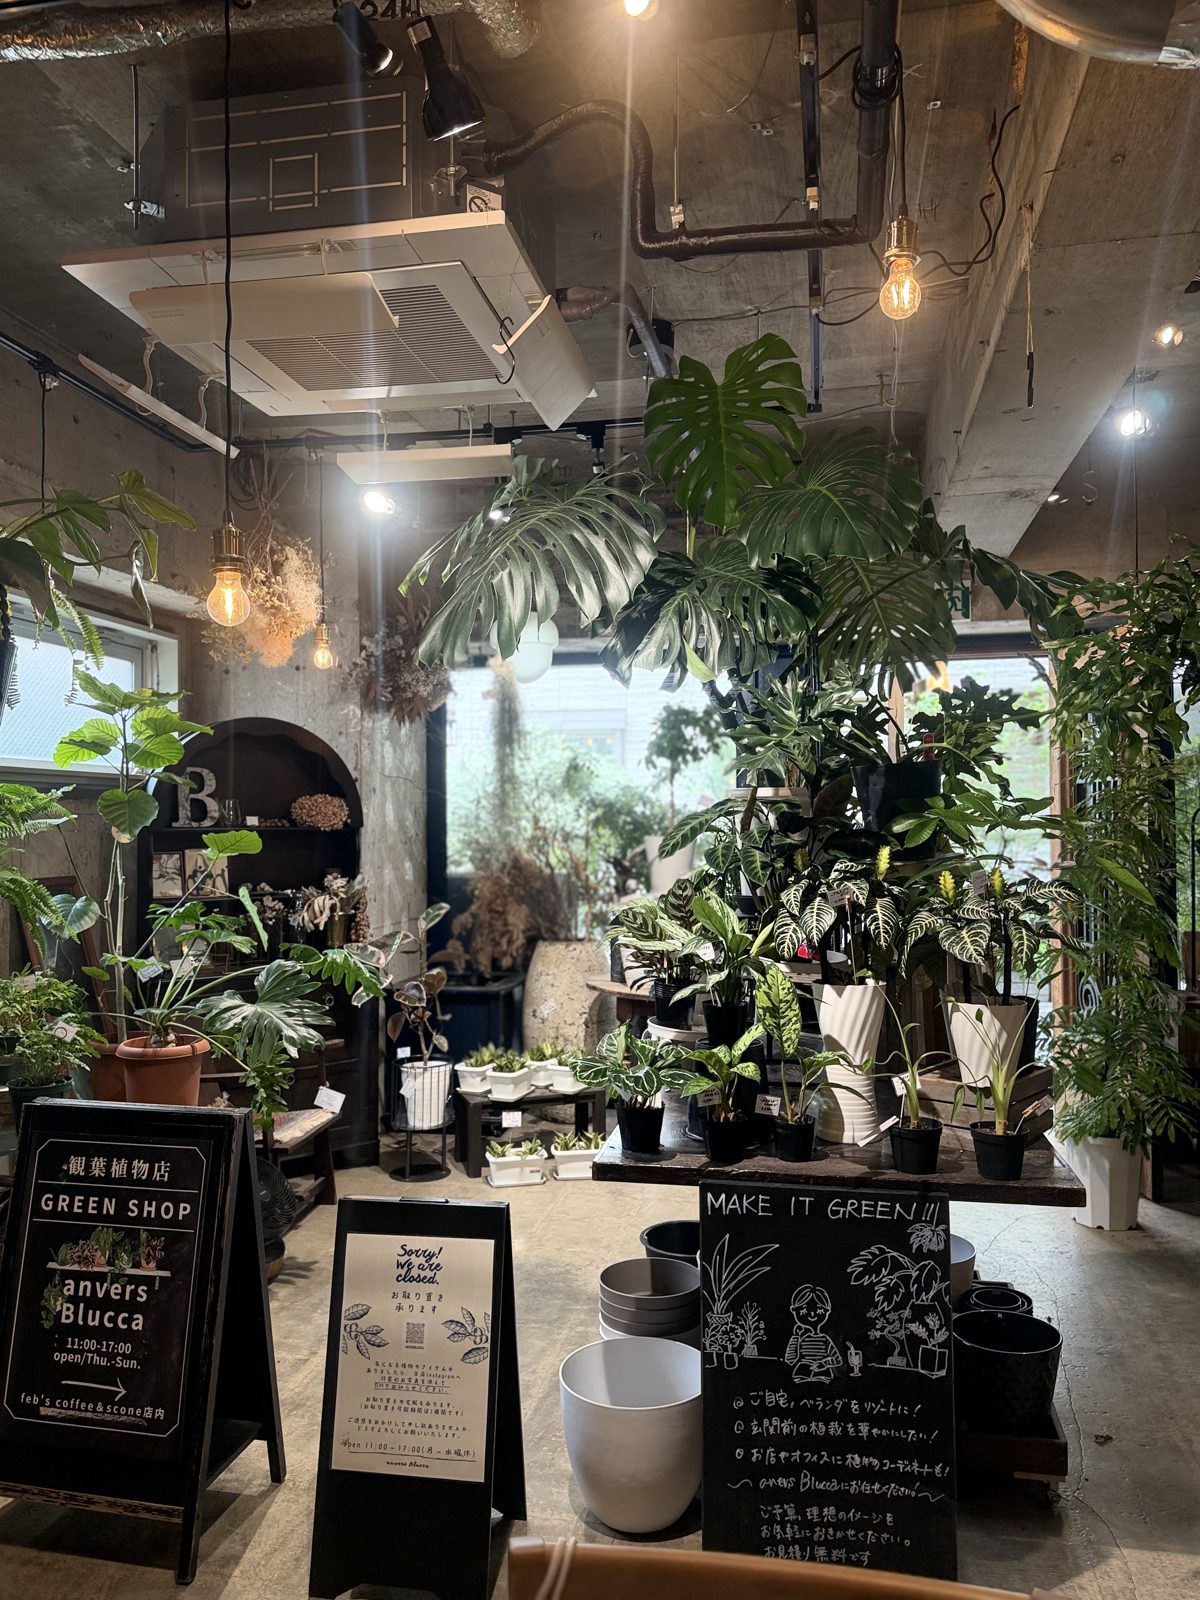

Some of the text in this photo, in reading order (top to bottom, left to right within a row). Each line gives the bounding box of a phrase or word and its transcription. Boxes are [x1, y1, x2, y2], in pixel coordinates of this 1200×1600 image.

[171, 767, 219, 828] B
[67, 1155, 171, 1182] 観葉植物店
[41, 1193, 192, 1221] GREEN SHOP
[706, 1191, 773, 1217] MAKE
[790, 1196, 815, 1217] IT
[397, 1243, 444, 1263] Sorry!
[396, 1258, 443, 1273] We are
[396, 1270, 440, 1285] closed.
[62, 1278, 148, 1302] anvers
[391, 1291, 444, 1303] お取り置き
[60, 1302, 144, 1331] Blucca
[394, 1303, 439, 1314] 承ります
[66, 1337, 132, 1354] 11:00-17:00
[53, 1351, 141, 1370] open/Thu.-Sun.
